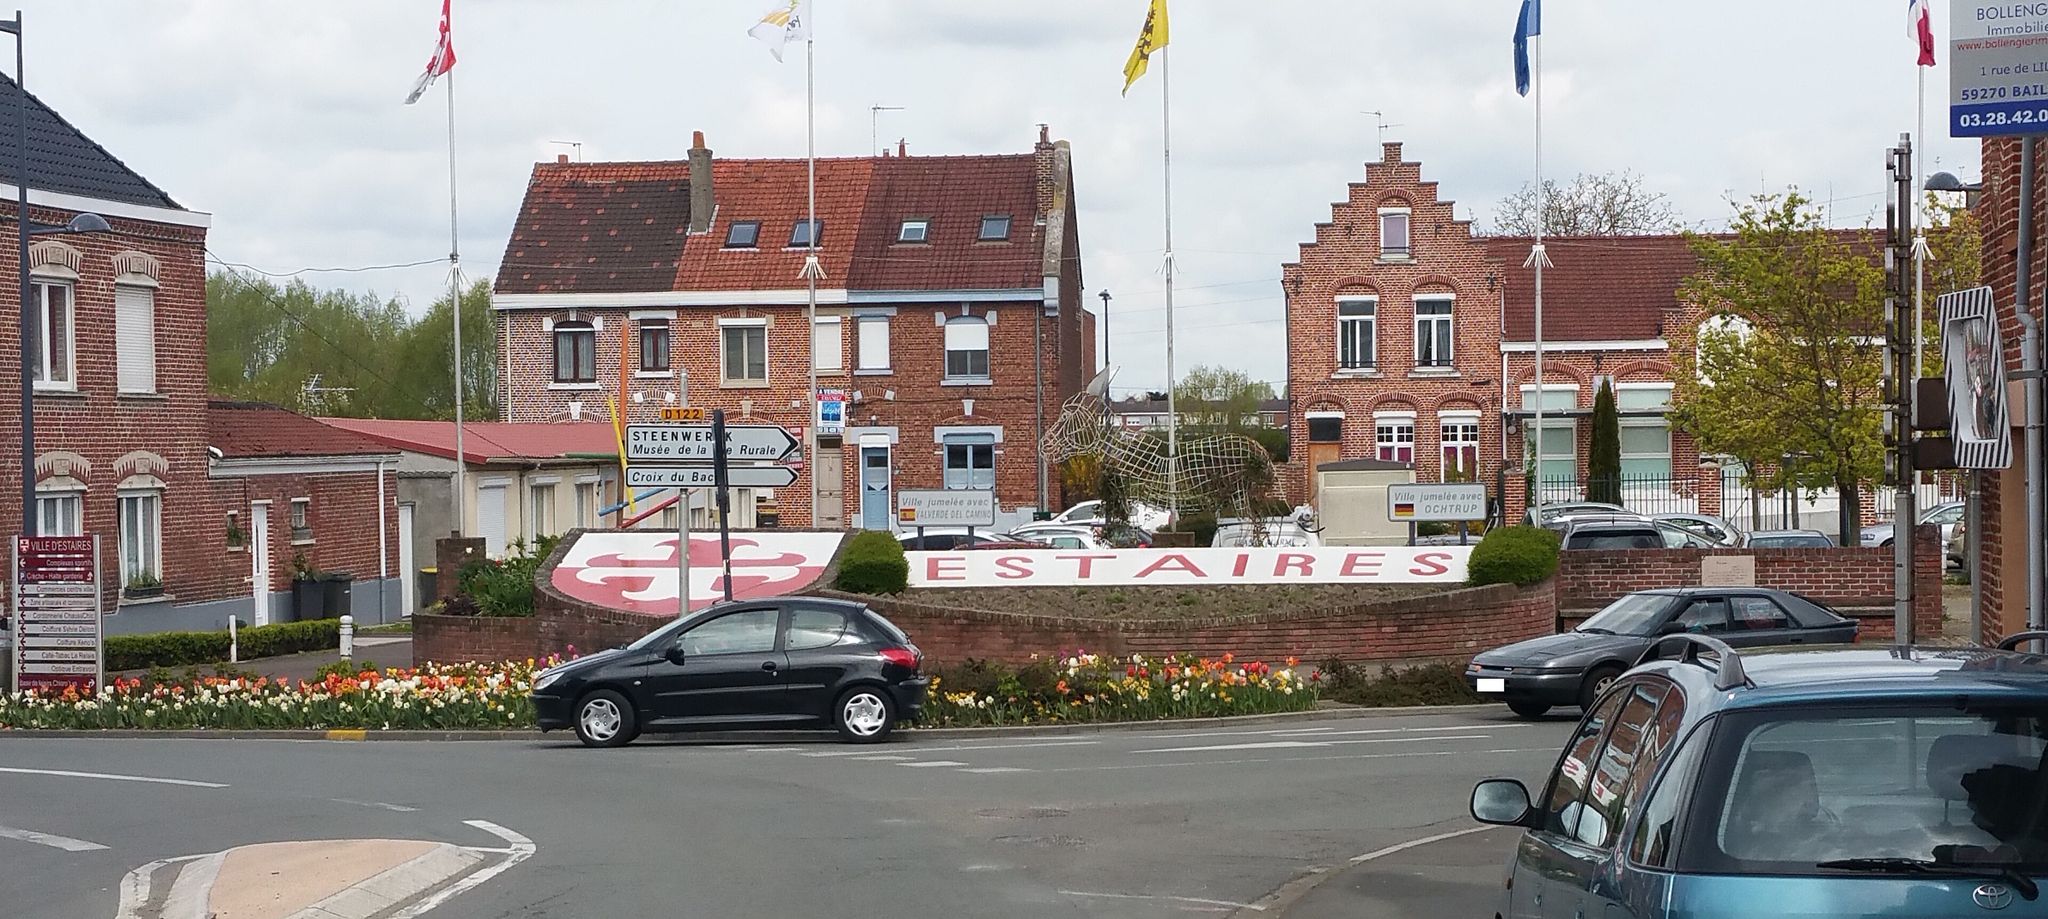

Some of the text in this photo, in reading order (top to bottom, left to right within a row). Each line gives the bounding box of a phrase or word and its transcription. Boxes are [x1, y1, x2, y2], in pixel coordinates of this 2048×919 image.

[1977, 3, 2047, 20] BOLLENG
[1982, 67, 1986, 76] 1
[1992, 66, 2010, 75] rue
[2014, 64, 2028, 73] de
[1962, 85, 2047, 100] 59270 BAIL
[1960, 110, 2048, 127] 03.28.42.0
[676, 409, 700, 419] 122
[633, 432, 732, 442] STEENWERK
[632, 444, 670, 455] Musée
[678, 444, 691, 455] de
[697, 445, 706, 454] la
[740, 445, 776, 455] Rurale
[632, 472, 714, 482] Croix du Bac
[1394, 492, 1414, 501] Ville
[928, 498, 964, 508] jumelée
[916, 510, 991, 518] VALVERDE DEL CAMINO
[1425, 505, 1477, 513] OCHTRUP
[30, 541, 92, 551] VILLE D'ESTAIRES
[926, 552, 1455, 580] ESTAIRES
